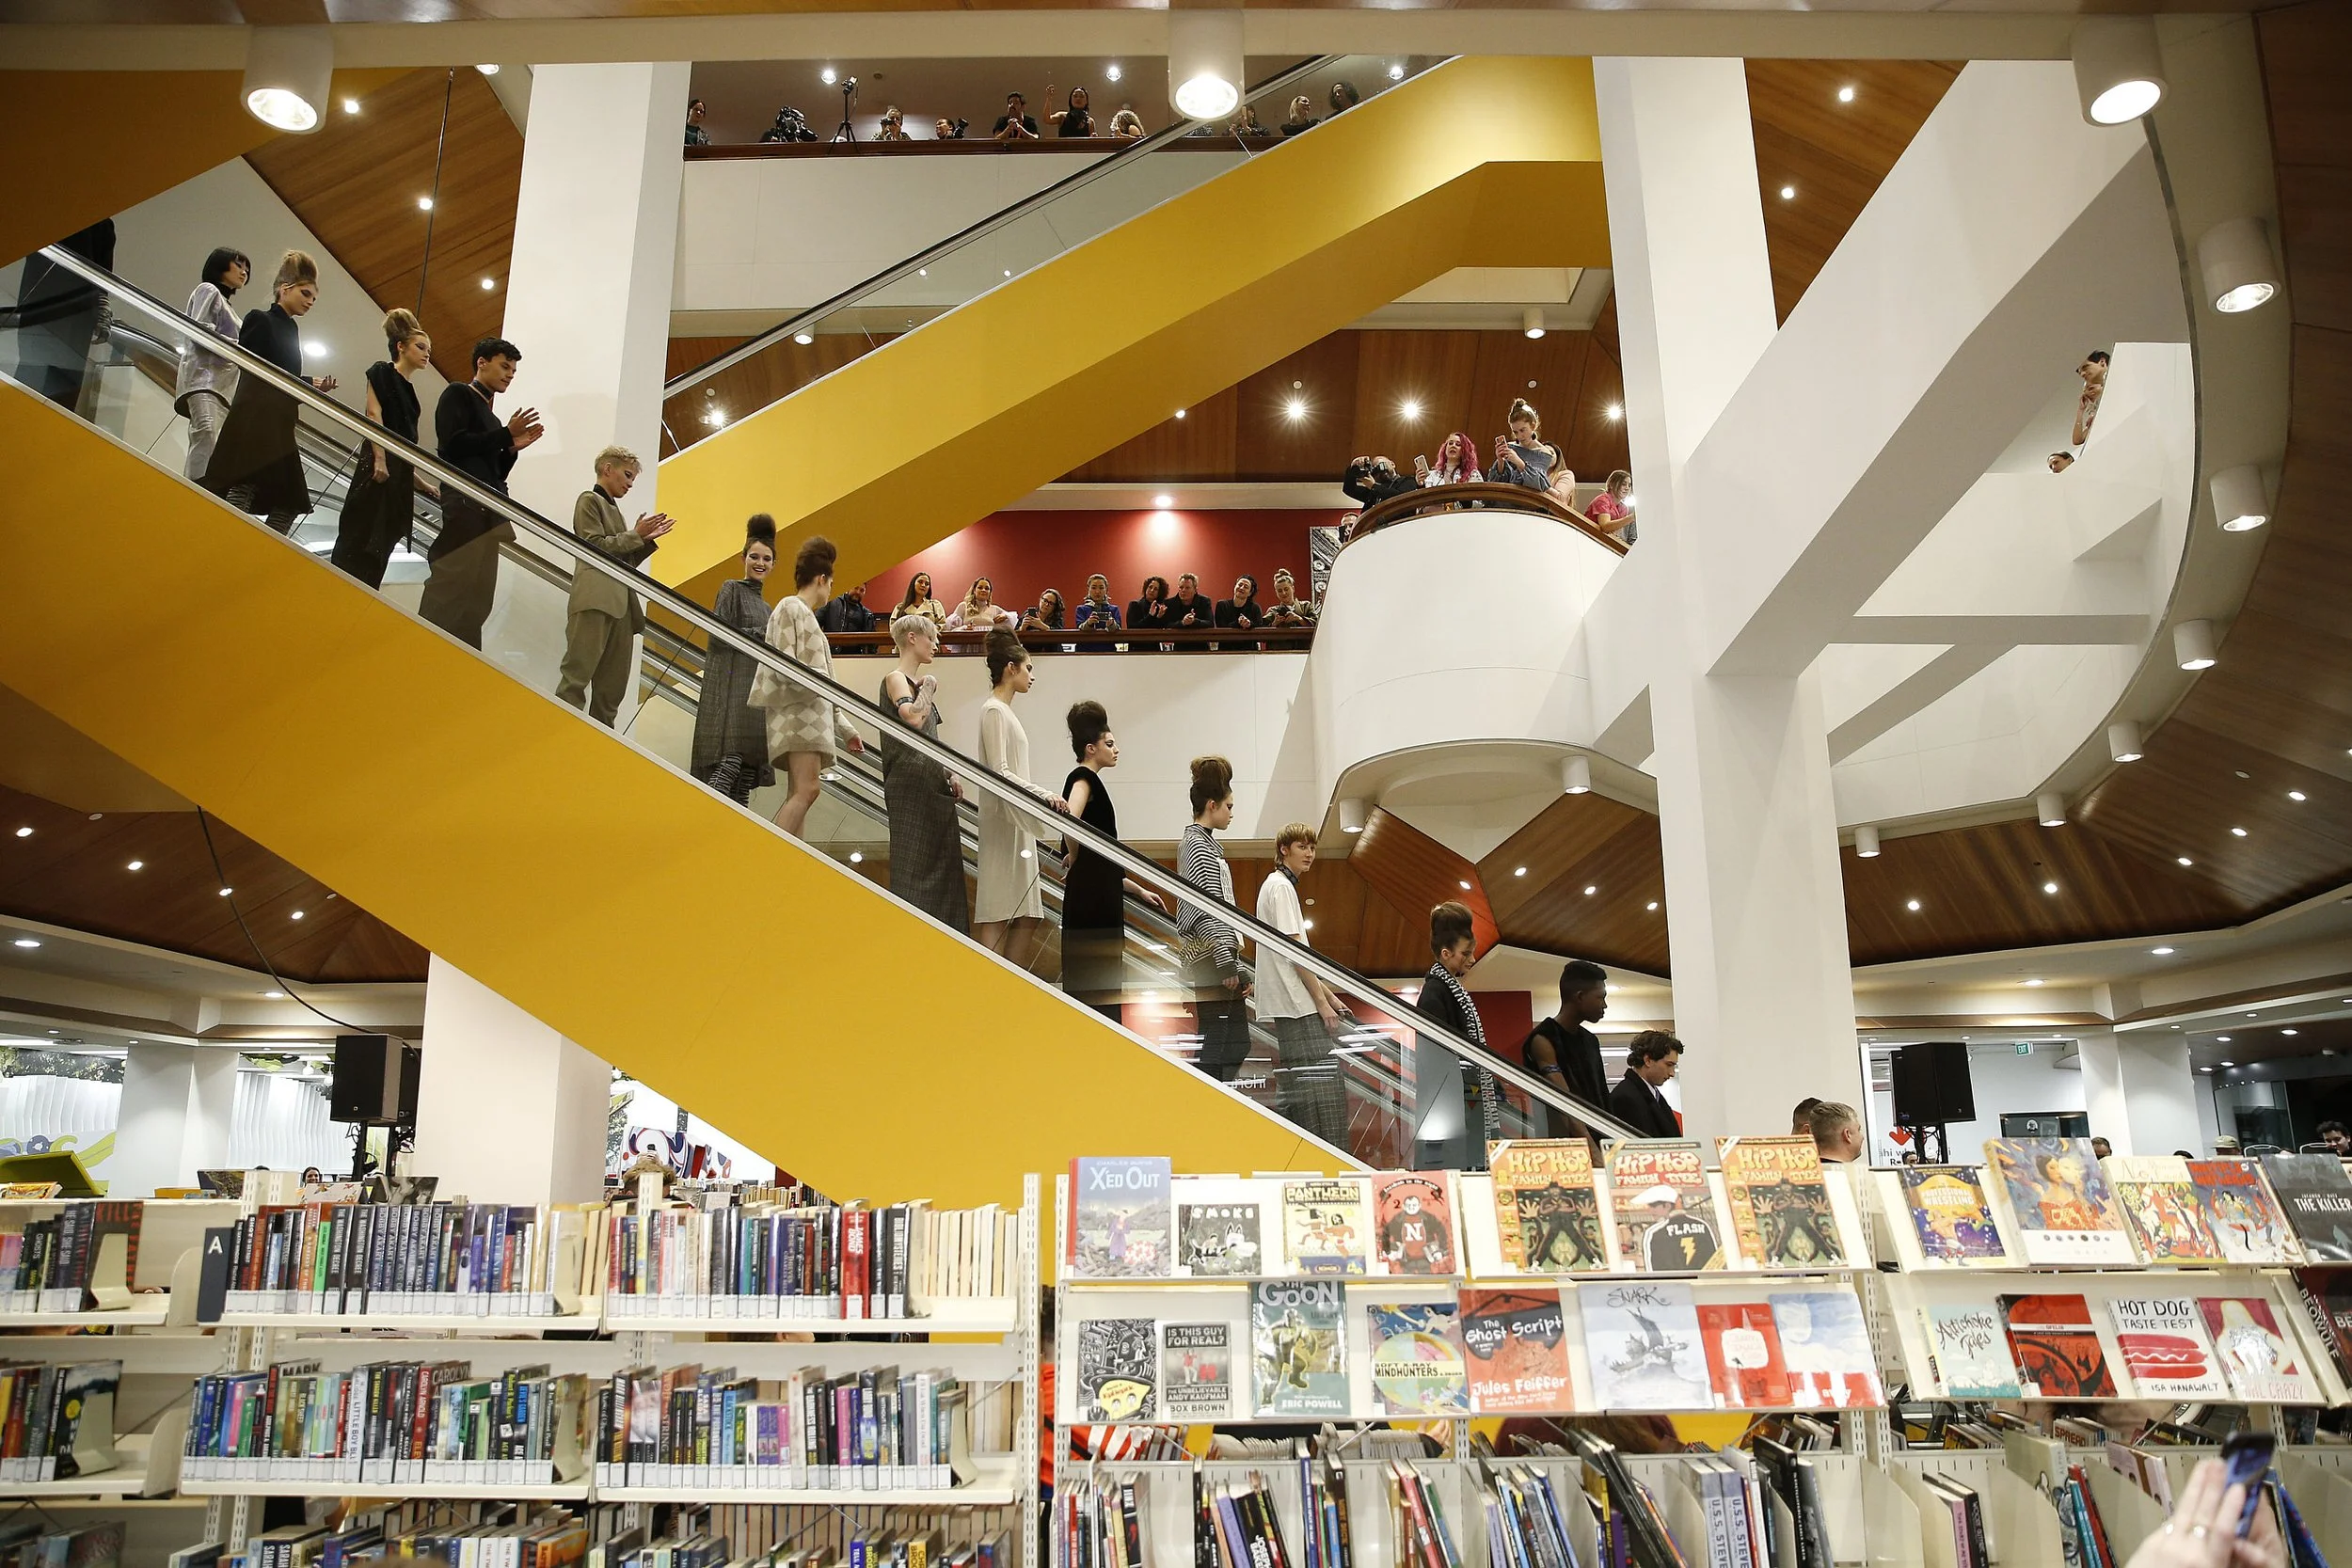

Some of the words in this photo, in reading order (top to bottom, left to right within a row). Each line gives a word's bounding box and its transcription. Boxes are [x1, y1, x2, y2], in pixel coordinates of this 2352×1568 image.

[1089, 1166, 1123, 1191] X'ED
[1126, 1165, 1160, 1190] OUT
[1286, 1187, 1360, 1201] PANTHEON
[1921, 1188, 1971, 1198] PROFESSIONAL
[1928, 1196, 1974, 1206] WRESTLING
[66, 1210, 76, 1219] HE
[338, 1208, 346, 1218] THE
[360, 1208, 369, 1218] THE
[1394, 1200, 1401, 1209] 2
[2294, 1199, 2316, 1212] THE
[378, 1207, 387, 1234] BOBBY
[390, 1207, 399, 1234] BOBBY
[402, 1207, 411, 1234] BOBBY
[412, 1211, 421, 1237] BOBBY
[421, 1207, 430, 1233] BOBBY
[433, 1207, 441, 1233] BOBBY
[1667, 1224, 1705, 1236] FLASH
[334, 1219, 346, 1253] WASHINGTON
[356, 1219, 368, 1253] WASHINGTON
[848, 1227, 856, 1252] BOND
[855, 1227, 864, 1255] JAMES
[1404, 1222, 1423, 1242] N
[33, 1233, 44, 1259] GHOSTS
[61, 1237, 73, 1250] SHE
[208, 1235, 223, 1254] A
[374, 1235, 385, 1260] AKART
[387, 1235, 397, 1260] AKART
[399, 1235, 408, 1260] AKART
[407, 1239, 418, 1263] AKART
[418, 1234, 427, 1259] AKART
[430, 1234, 439, 1259] AKART
[60, 1251, 71, 1264] SAID
[332, 1254, 342, 1274] DECREE
[354, 1254, 364, 1274] DECREE
[1259, 1281, 1339, 1307] GOON
[2119, 1301, 2147, 1317] HOT
[2153, 1300, 2190, 1316] DOG
[1180, 1327, 1202, 1336] THIS
[1204, 1326, 1224, 1335] GUY
[1466, 1328, 1507, 1344] Ghost
[1512, 1315, 1563, 1337] Script
[1484, 1320, 1500, 1329] The
[1936, 1312, 1993, 1349] Artichoke
[2122, 1319, 2157, 1330] TASTE
[2163, 1318, 2195, 1329] TEST
[2300, 1289, 2340, 1359] BEOWULF
[1168, 1337, 1188, 1346] FOR
[1191, 1336, 1224, 1345] REAL?
[1961, 1331, 1992, 1359] Tales
[420, 1370, 429, 1395] CAROLYN
[433, 1366, 470, 1385] CAROLYN
[1375, 1368, 1438, 1377] MINDHUNTERS
[615, 1377, 627, 1395] MARK
[662, 1373, 673, 1402] WOLF
[1472, 1381, 1510, 1397] Jules
[1516, 1376, 1567, 1395] Feiffer
[2151, 1384, 2167, 1392] ISA
[2170, 1383, 2219, 1392] HANAWALT
[2270, 1385, 2303, 1400] CRAZY
[298, 1392, 308, 1407] BLACK
[372, 1399, 380, 1414] KILLER
[417, 1396, 426, 1418] ARNOLD
[1192, 1403, 1225, 1412] BROWN
[1281, 1400, 1303, 1409] ERIC
[1305, 1400, 1343, 1408] POWELL
[50, 1411, 59, 1433] DAUGHTER
[352, 1402, 361, 1430] LITTLE
[660, 1414, 671, 1452] STRING
[515, 1445, 525, 1455] ACE
[1712, 1498, 1723, 1530] U.S.S.
[1732, 1498, 1744, 1530] U.S.S.
[262, 1545, 276, 1568] SARAH
[278, 1544, 291, 1568] SARAH
